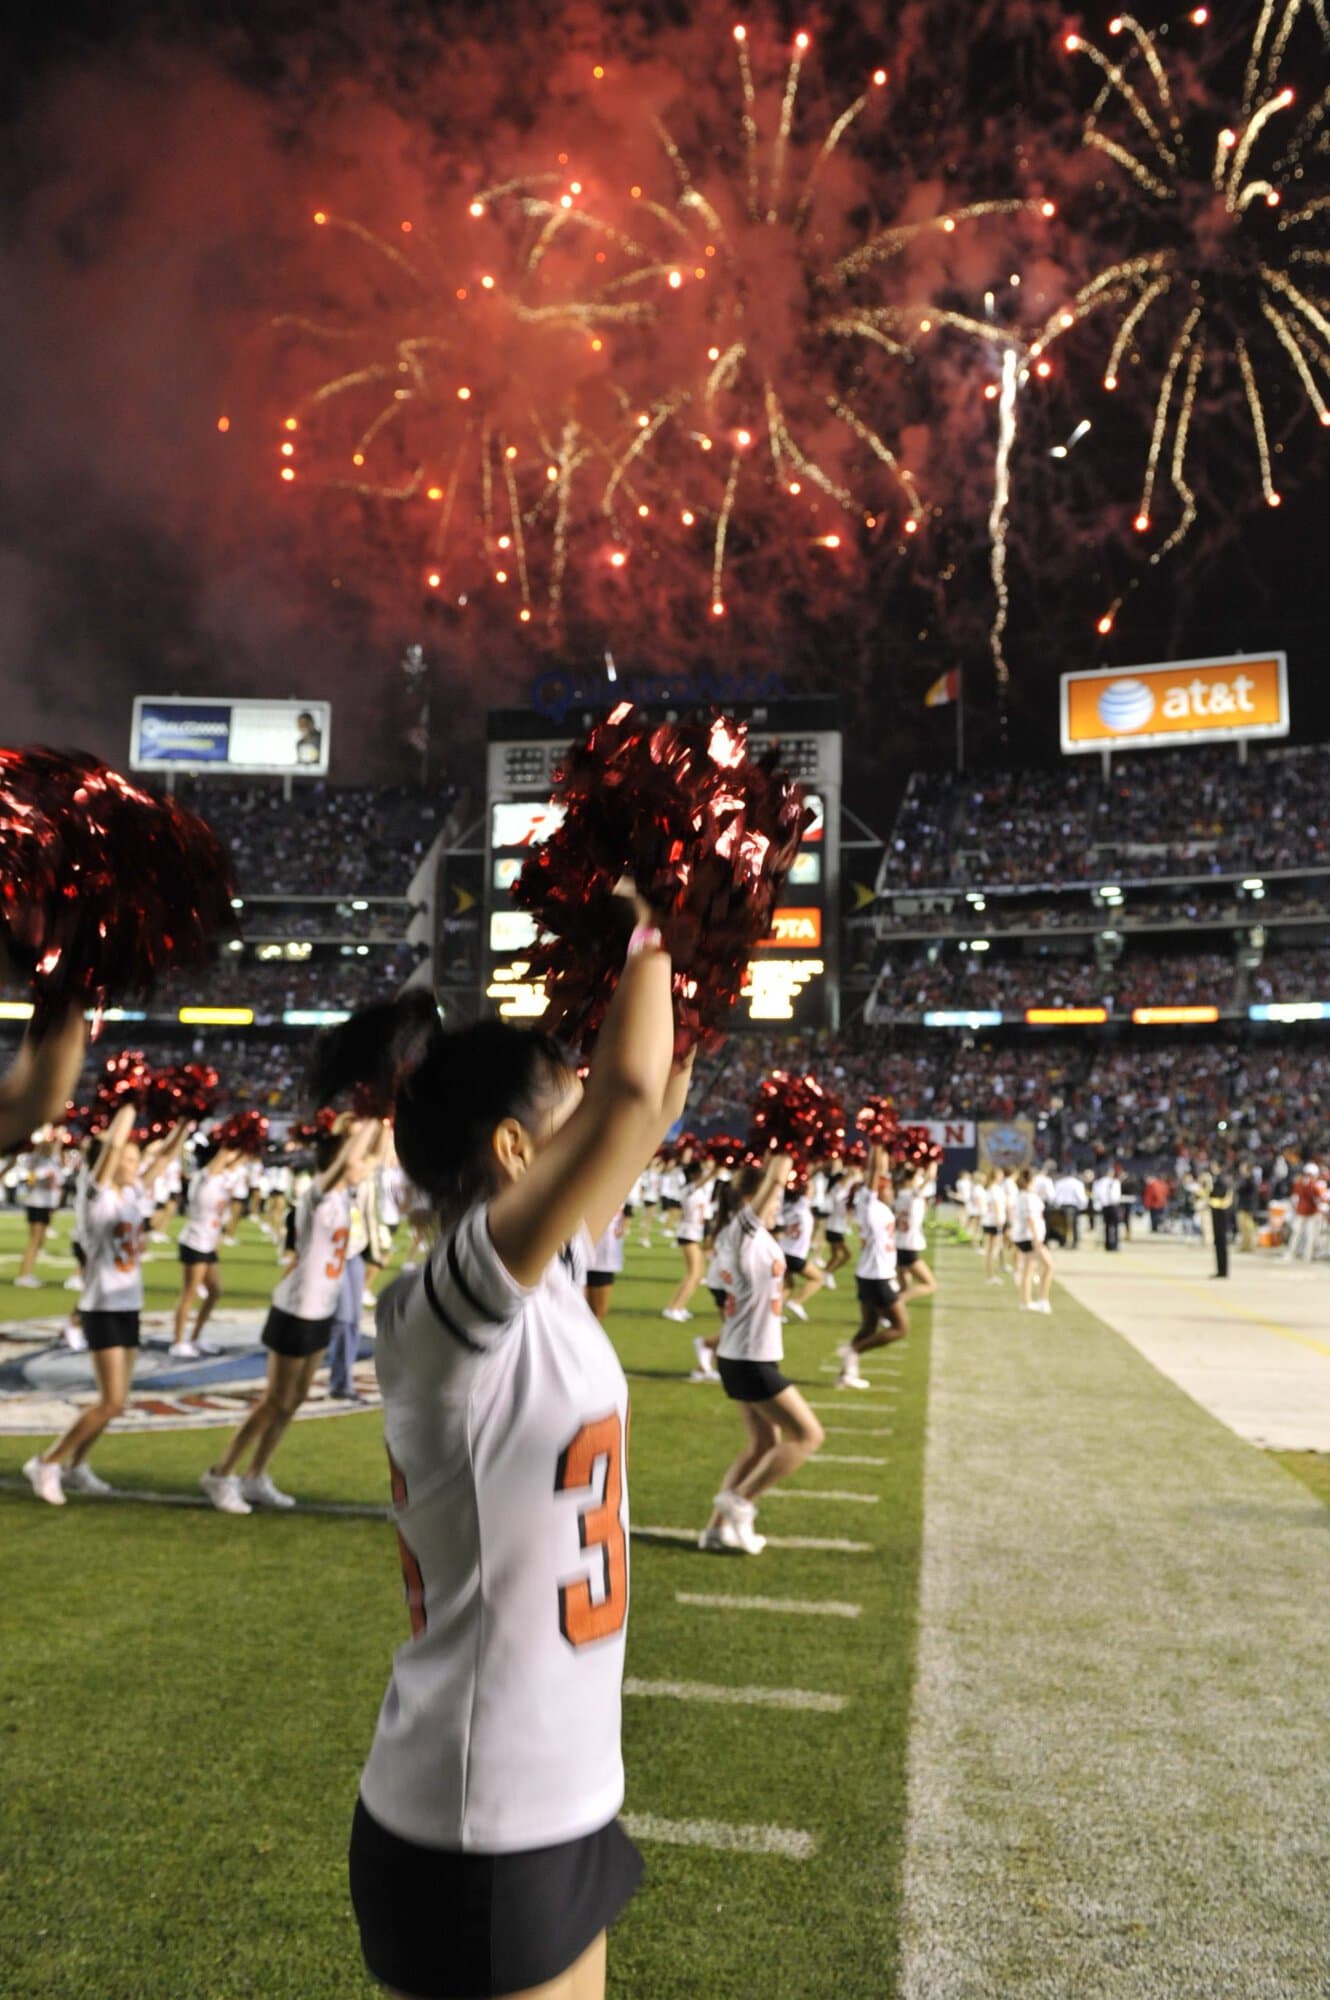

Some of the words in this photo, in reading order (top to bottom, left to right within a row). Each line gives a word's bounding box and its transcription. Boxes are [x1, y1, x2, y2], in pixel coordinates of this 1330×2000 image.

[1163, 674, 1255, 718] at&t
[771, 917, 816, 939] OTA
[944, 1125, 965, 1143] N
[554, 1408, 630, 1649] 3
